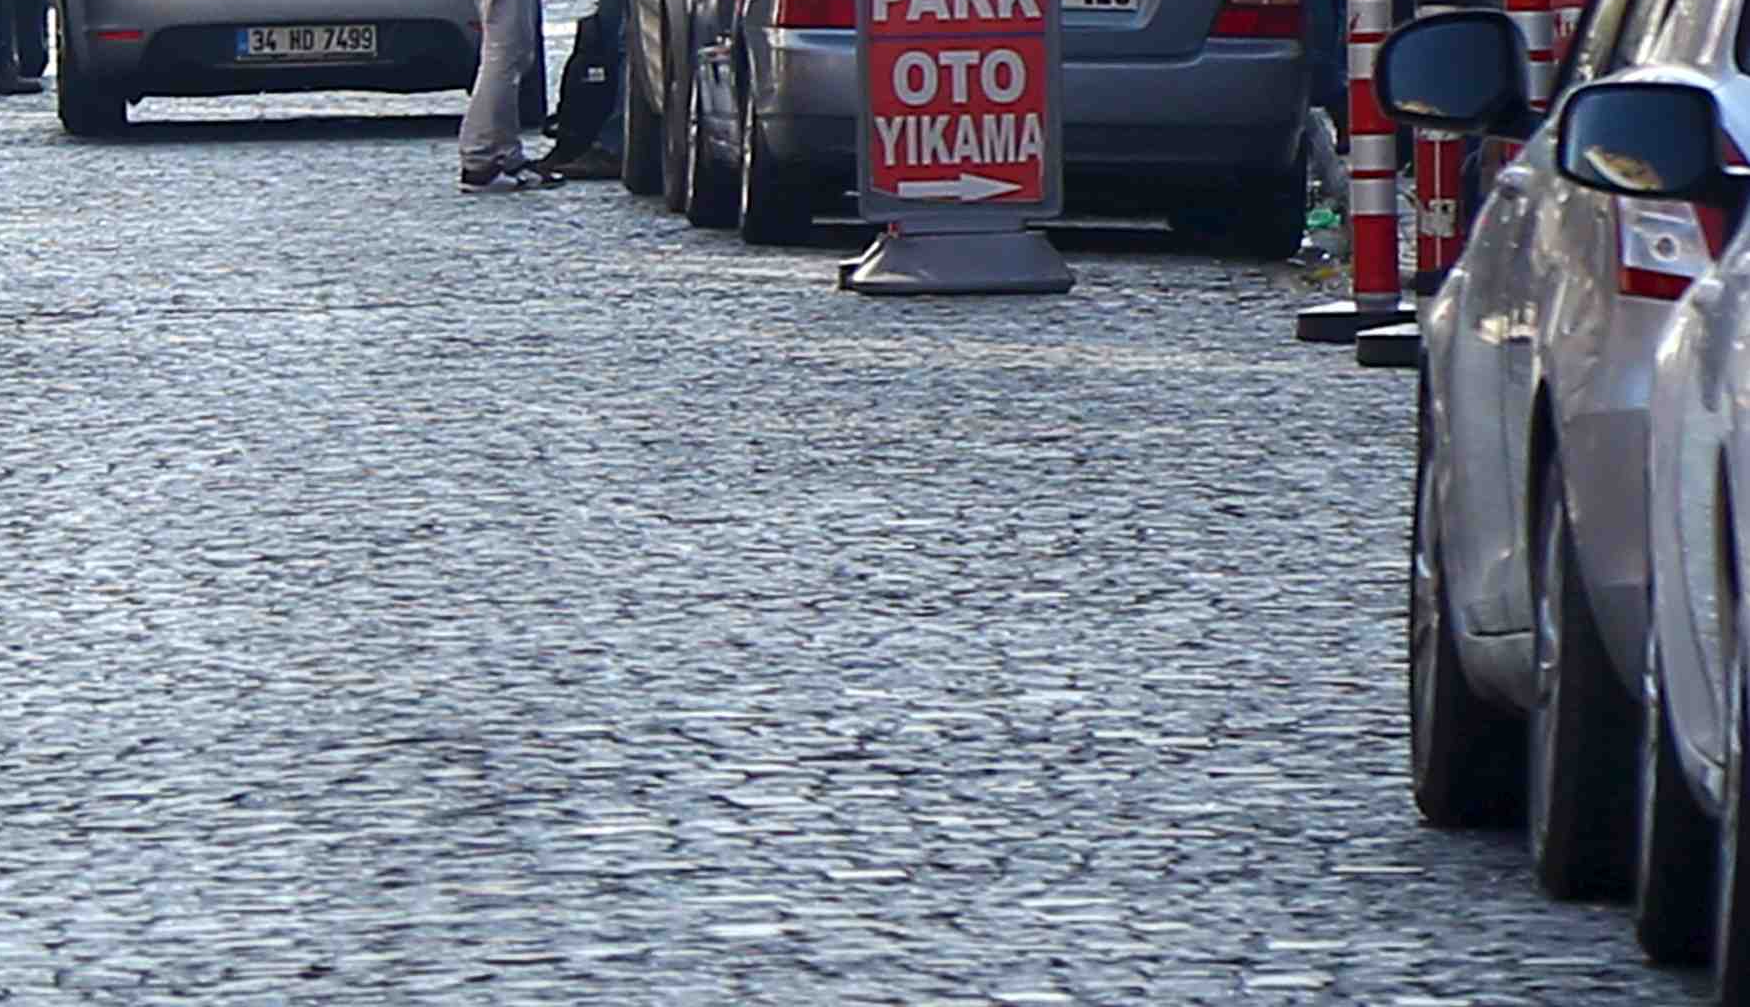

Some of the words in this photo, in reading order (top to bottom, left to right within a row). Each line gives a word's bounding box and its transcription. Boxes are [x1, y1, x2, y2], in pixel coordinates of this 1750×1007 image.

[252, 30, 277, 51] 34
[290, 30, 315, 50] HD
[322, 27, 373, 50] 7499
[893, 48, 1027, 106] OTO
[874, 112, 1045, 167] YIKAMA
